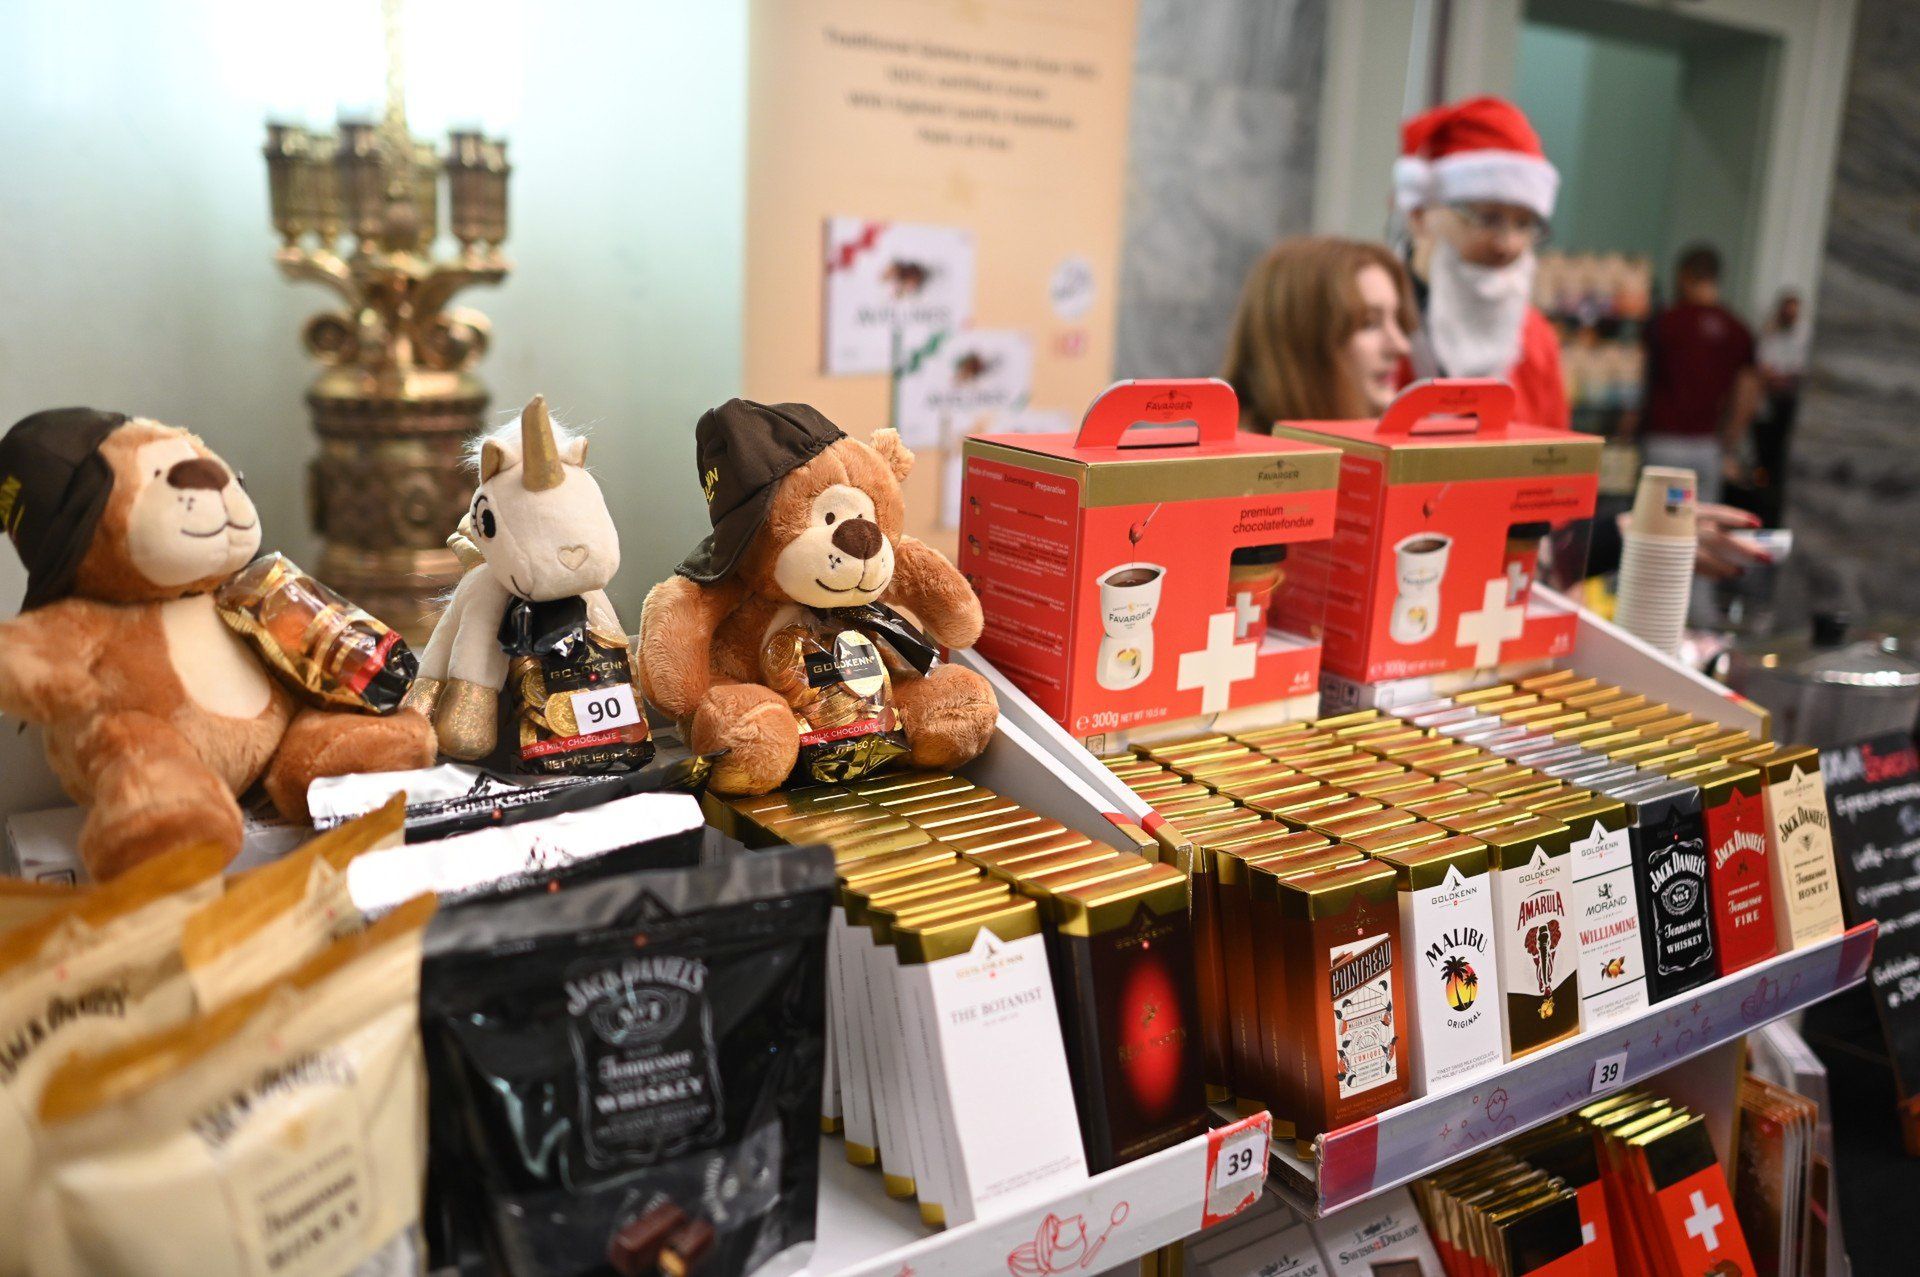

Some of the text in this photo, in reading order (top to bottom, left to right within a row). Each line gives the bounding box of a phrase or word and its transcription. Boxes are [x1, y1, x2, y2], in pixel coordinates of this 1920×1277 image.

[1257, 470, 1300, 481] FAVARGER
[1035, 481, 1067, 496] Preparation
[1240, 506, 1284, 521] premium
[1232, 517, 1315, 534] chocolatefondue
[1108, 607, 1153, 623] FAVARGER
[812, 655, 875, 675] GOLDKENN
[587, 697, 622, 724] 90
[1092, 711, 1119, 728] 300g
[831, 722, 878, 738] CHOCOLATE
[522, 744, 545, 758] SWISS
[567, 732, 618, 748] CHOCOLATE
[1778, 805, 1827, 844] JACK DANIEL'S
[1581, 841, 1619, 857] GOLDKENN
[1713, 829, 1766, 871] JACK DANIEL'S
[1518, 865, 1561, 884] GOLDKENN
[1649, 850, 1706, 893] JACK DANIEL'S
[1431, 886, 1478, 905] GOLDKENN
[1798, 880, 1830, 901] HONEY
[1517, 890, 1565, 931] AMARULA
[1585, 895, 1628, 917] MORAND
[1663, 917, 1702, 939] Tennessee
[1734, 908, 1760, 929] FIRE
[1579, 916, 1638, 946] WILLIAMINE
[1425, 926, 1488, 968] MALIBU
[1666, 933, 1703, 955] WHISKEY
[1331, 940, 1393, 998] COINTREAU
[563, 969, 624, 1017] JACK
[951, 985, 1042, 1025] THE BOTANIST
[1447, 1010, 1482, 1029] ORIGINAL
[1600, 1062, 1619, 1084] 39
[1227, 1147, 1253, 1177] 39
